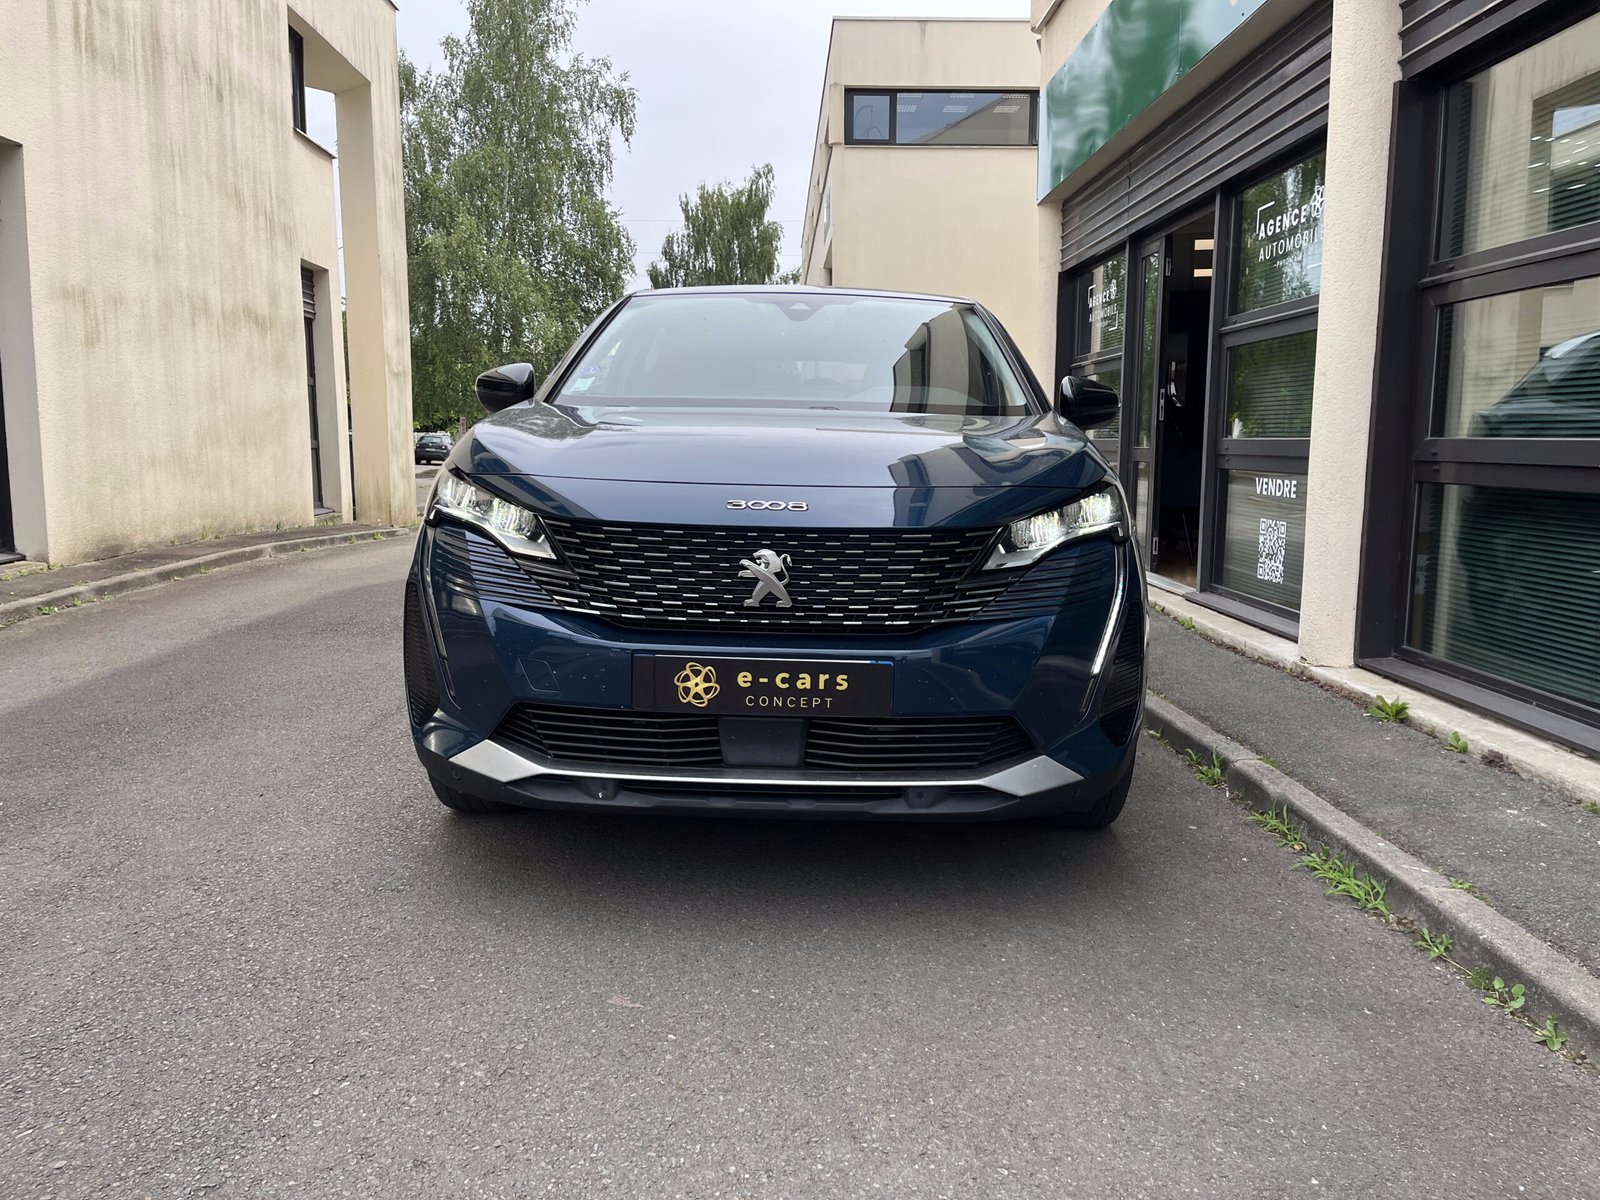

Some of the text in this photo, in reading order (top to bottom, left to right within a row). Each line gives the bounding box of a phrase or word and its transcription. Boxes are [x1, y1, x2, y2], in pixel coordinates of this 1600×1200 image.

[1259, 204, 1307, 240] AGENCE
[1259, 225, 1325, 262] AUTOMOBILE
[1255, 477, 1297, 498] VENDRE
[726, 499, 808, 512] 3008
[737, 671, 848, 691] e-cars
[745, 695, 833, 709] CONCEPT
